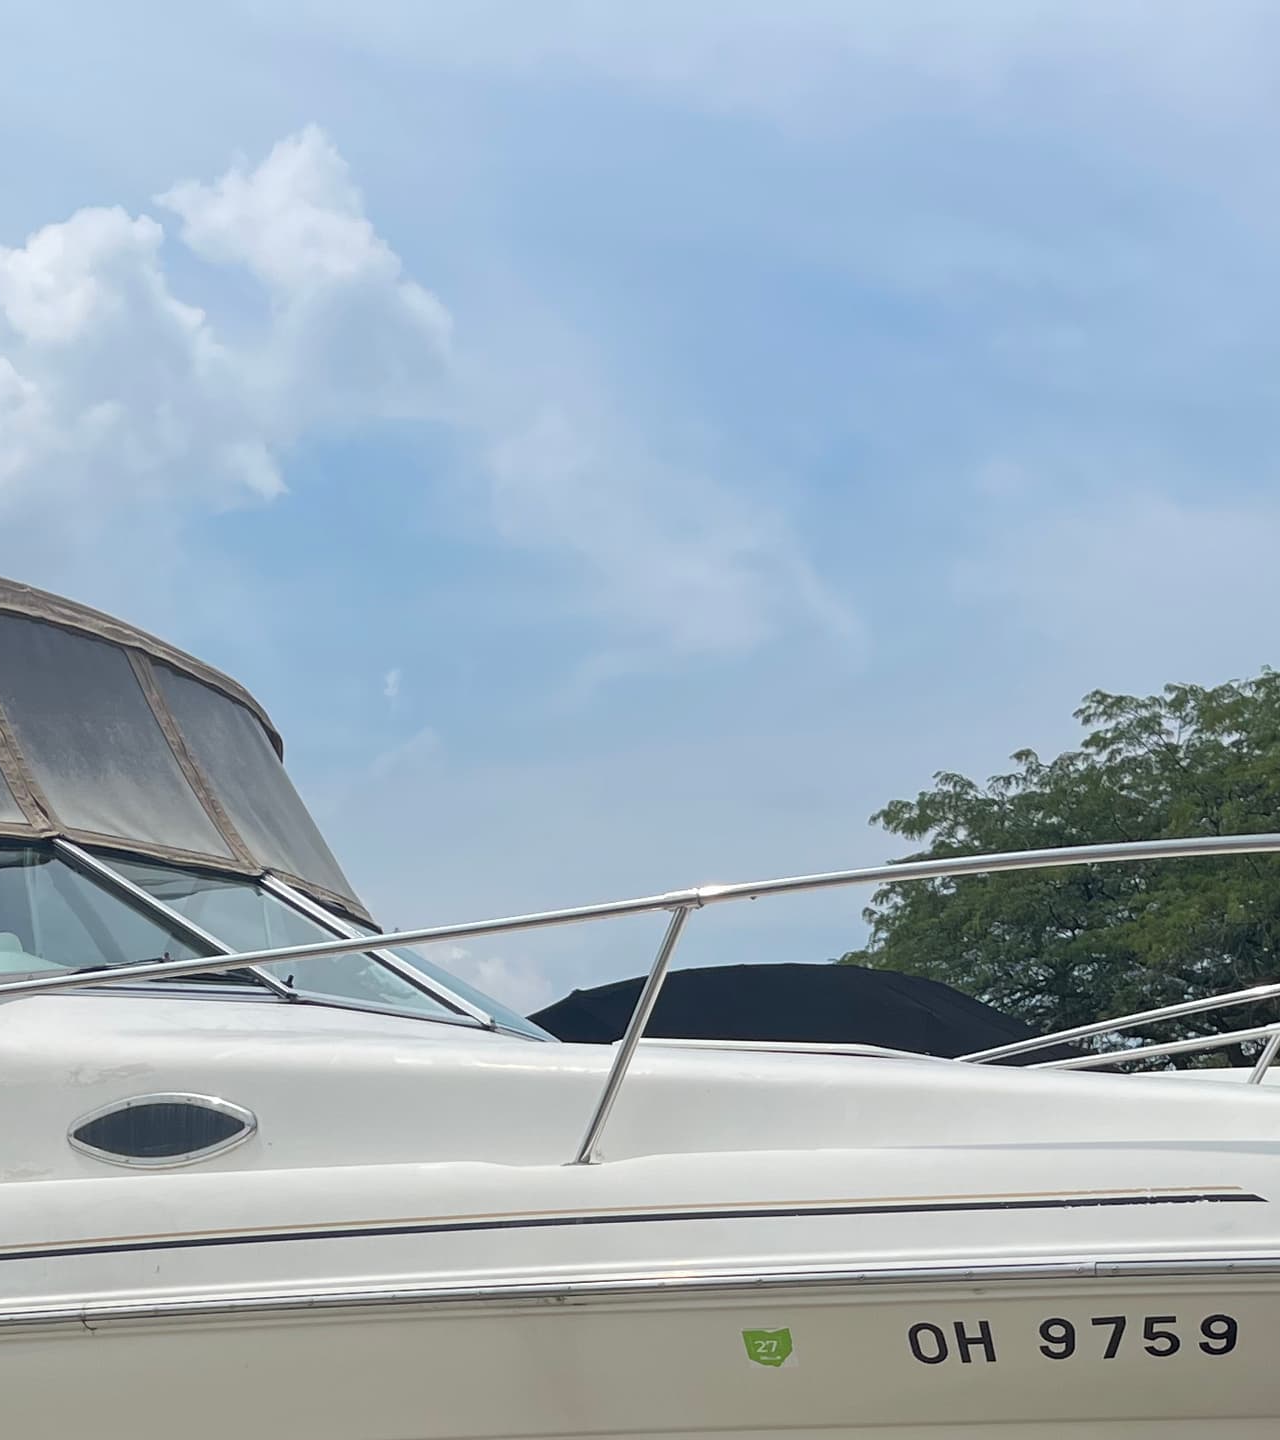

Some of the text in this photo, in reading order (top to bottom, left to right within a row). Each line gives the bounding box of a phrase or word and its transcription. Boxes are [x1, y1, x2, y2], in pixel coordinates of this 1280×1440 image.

[753, 1340, 778, 1353] 27
[908, 1320, 997, 1364] OH
[1039, 1314, 1238, 1361] 9759
